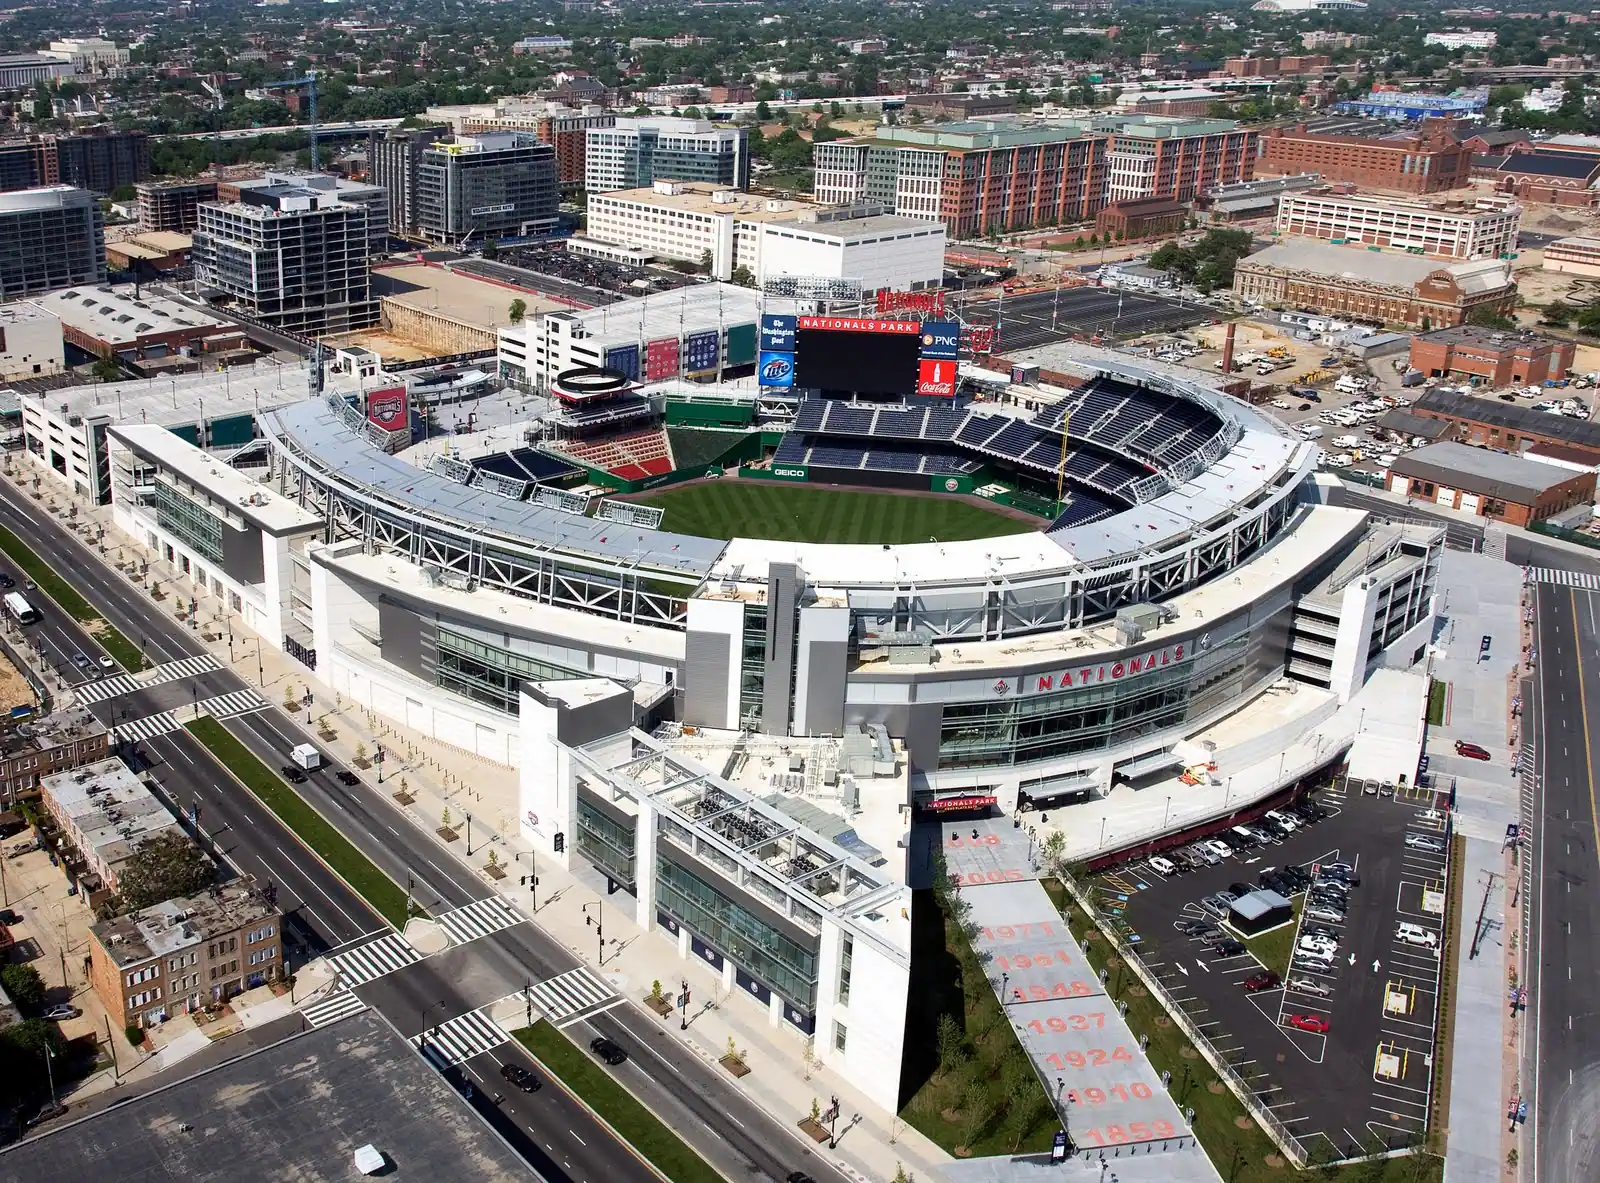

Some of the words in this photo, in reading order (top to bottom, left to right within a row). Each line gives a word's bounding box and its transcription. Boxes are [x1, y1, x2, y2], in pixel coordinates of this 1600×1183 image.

[803, 319, 875, 330] NATIONALS
[880, 322, 912, 332] PARK
[934, 335, 957, 346] PNC
[774, 468, 805, 477] GEICO
[1036, 644, 1185, 692] NATIONALS
[927, 799, 973, 808] NATIONALS
[980, 921, 1055, 941] 1971
[994, 949, 1072, 971] 1961
[1010, 980, 1092, 1002] 1948
[1027, 1012, 1105, 1035] 1937
[1044, 1045, 1133, 1071] 1924
[1064, 1082, 1153, 1107] 1910
[1085, 1118, 1175, 1145] 1859
